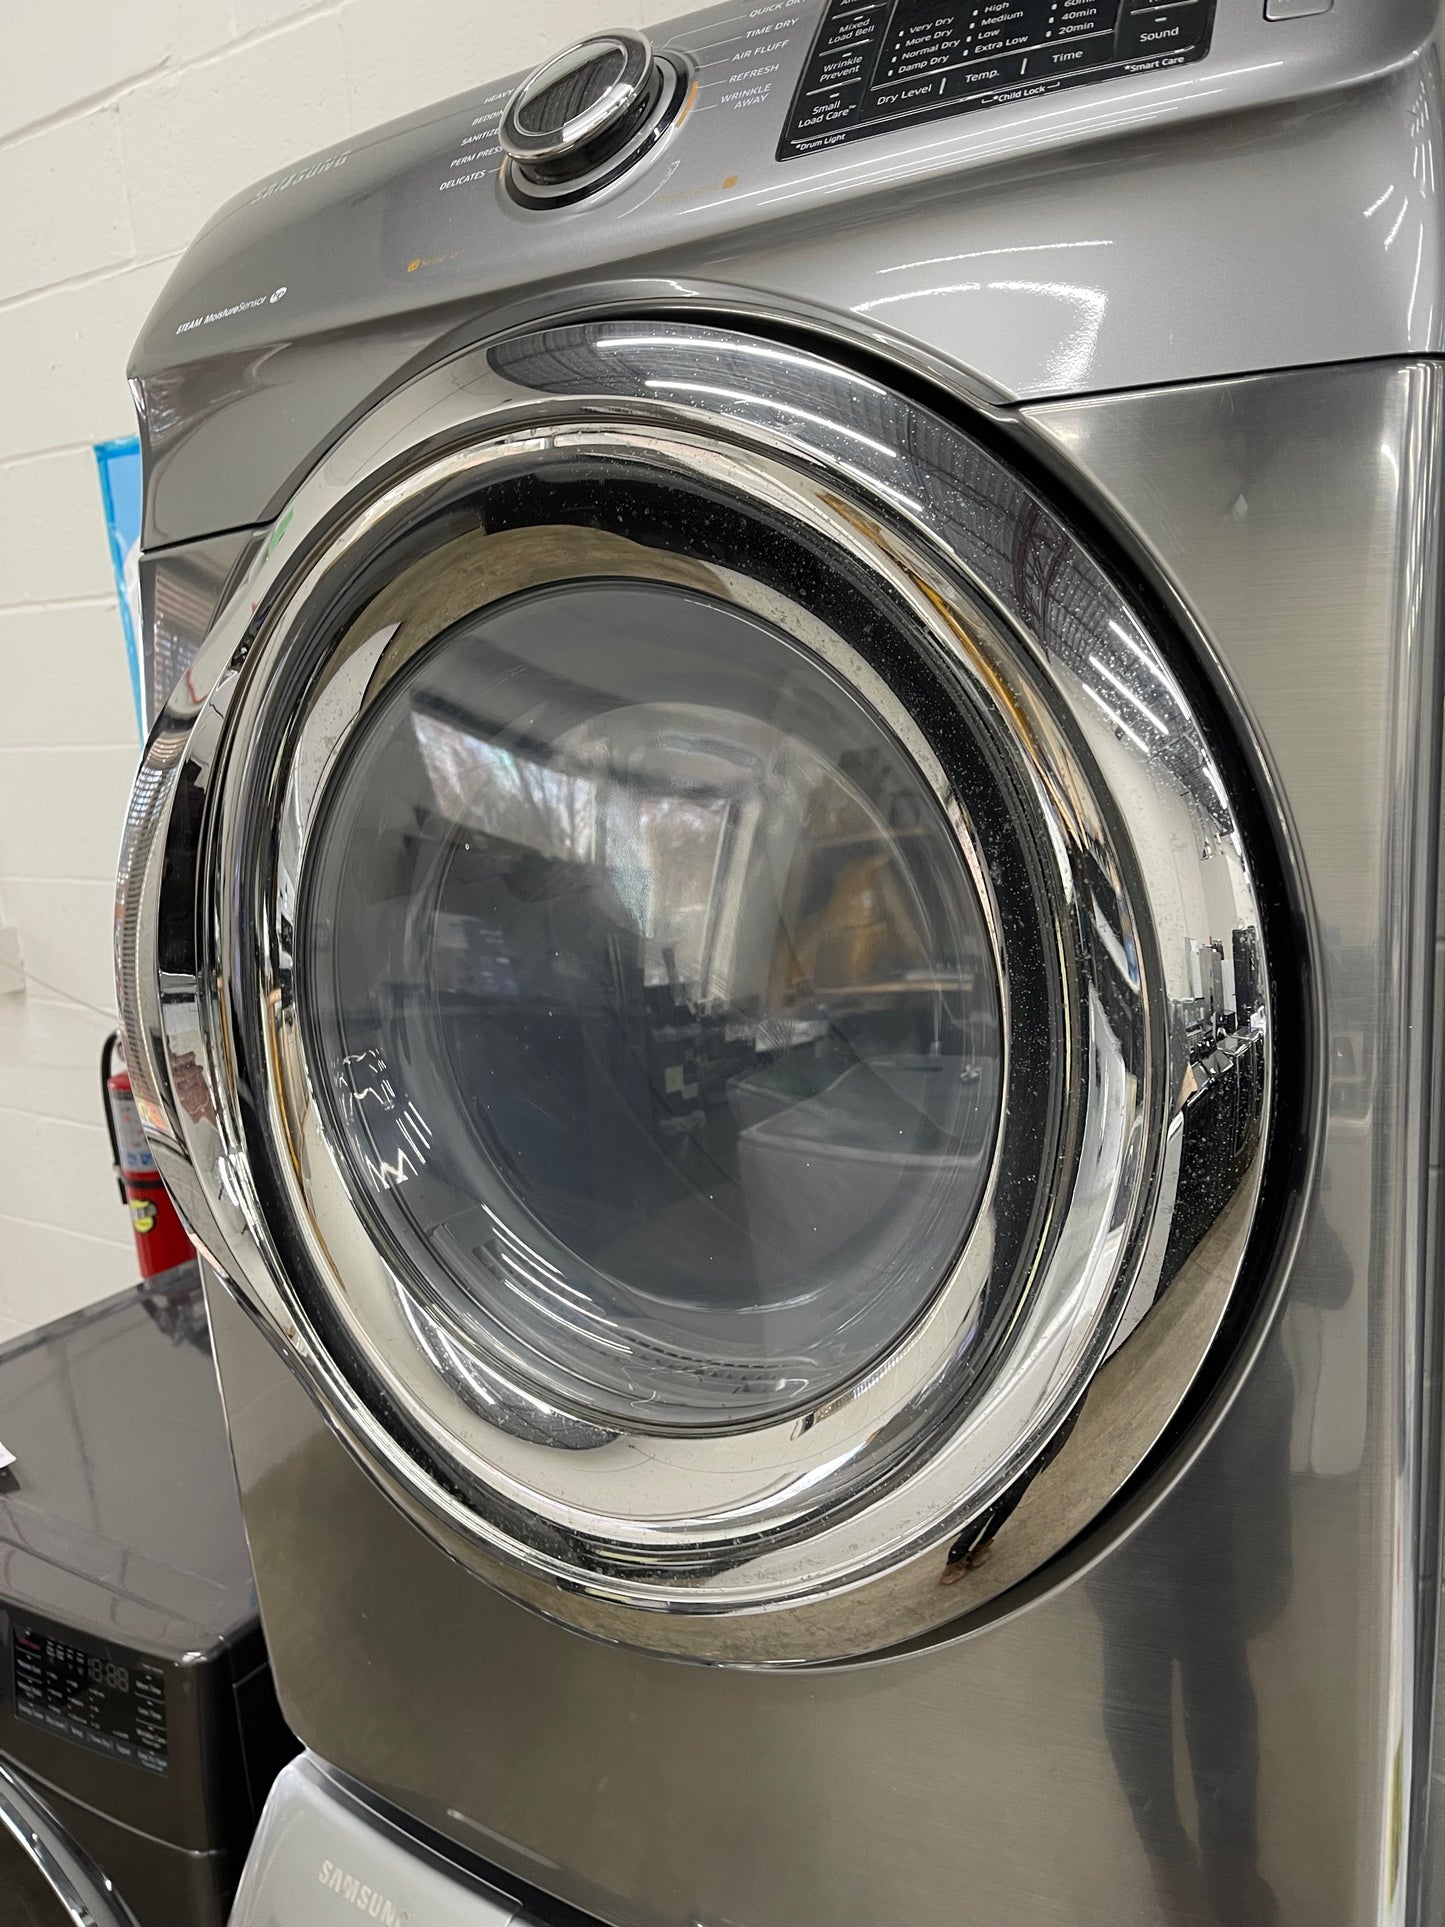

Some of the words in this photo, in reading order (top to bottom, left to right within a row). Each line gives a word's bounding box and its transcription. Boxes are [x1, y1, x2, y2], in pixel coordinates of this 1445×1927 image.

[749, 2, 784, 17] QUICK
[984, 2, 1010, 13] High
[1061, 7, 1097, 20] 40min
[839, 18, 871, 33] Mixed
[909, 22, 933, 34] Very
[935, 16, 954, 27] Dry
[981, 11, 1024, 26] Medium
[746, 24, 774, 39] TIME
[774, 17, 800, 31] DRY
[828, 31, 854, 45] Load
[855, 25, 875, 37] Bell
[978, 29, 1001, 40] Low
[1058, 21, 1095, 35] 20min
[1140, 26, 1180, 42] Sound
[905, 34, 932, 47] More
[934, 28, 953, 39] Dry
[974, 41, 1003, 54] Extra
[1005, 35, 1029, 46] Low
[731, 50, 752, 62] AIR
[754, 39, 790, 56] FLUFF
[901, 43, 940, 60] Normal
[941, 39, 961, 50] Dry
[1051, 50, 1084, 63] Time
[823, 56, 863, 73] Wrinkle
[898, 60, 928, 74] Damp
[929, 55, 950, 65] Dry
[1161, 56, 1185, 66] Care
[728, 63, 780, 84] REFRESH
[819, 65, 860, 82] Prevent
[965, 69, 1000, 84] Temp.
[483, 88, 515, 104] HEAVY
[721, 82, 773, 104] WRINKLE
[876, 93, 898, 106] Dry
[901, 84, 932, 99] Level
[1024, 85, 1046, 96] Lock
[733, 93, 769, 110] AWAY
[812, 100, 841, 115] Small
[471, 109, 503, 126] BEDDIN
[798, 114, 824, 129] Load
[460, 127, 501, 147] SANITIZE
[824, 133, 846, 145] Light
[450, 153, 476, 169] PERM
[476, 146, 504, 159] PRESS
[439, 169, 487, 191] DELICATES
[175, 317, 204, 335] STEAM
